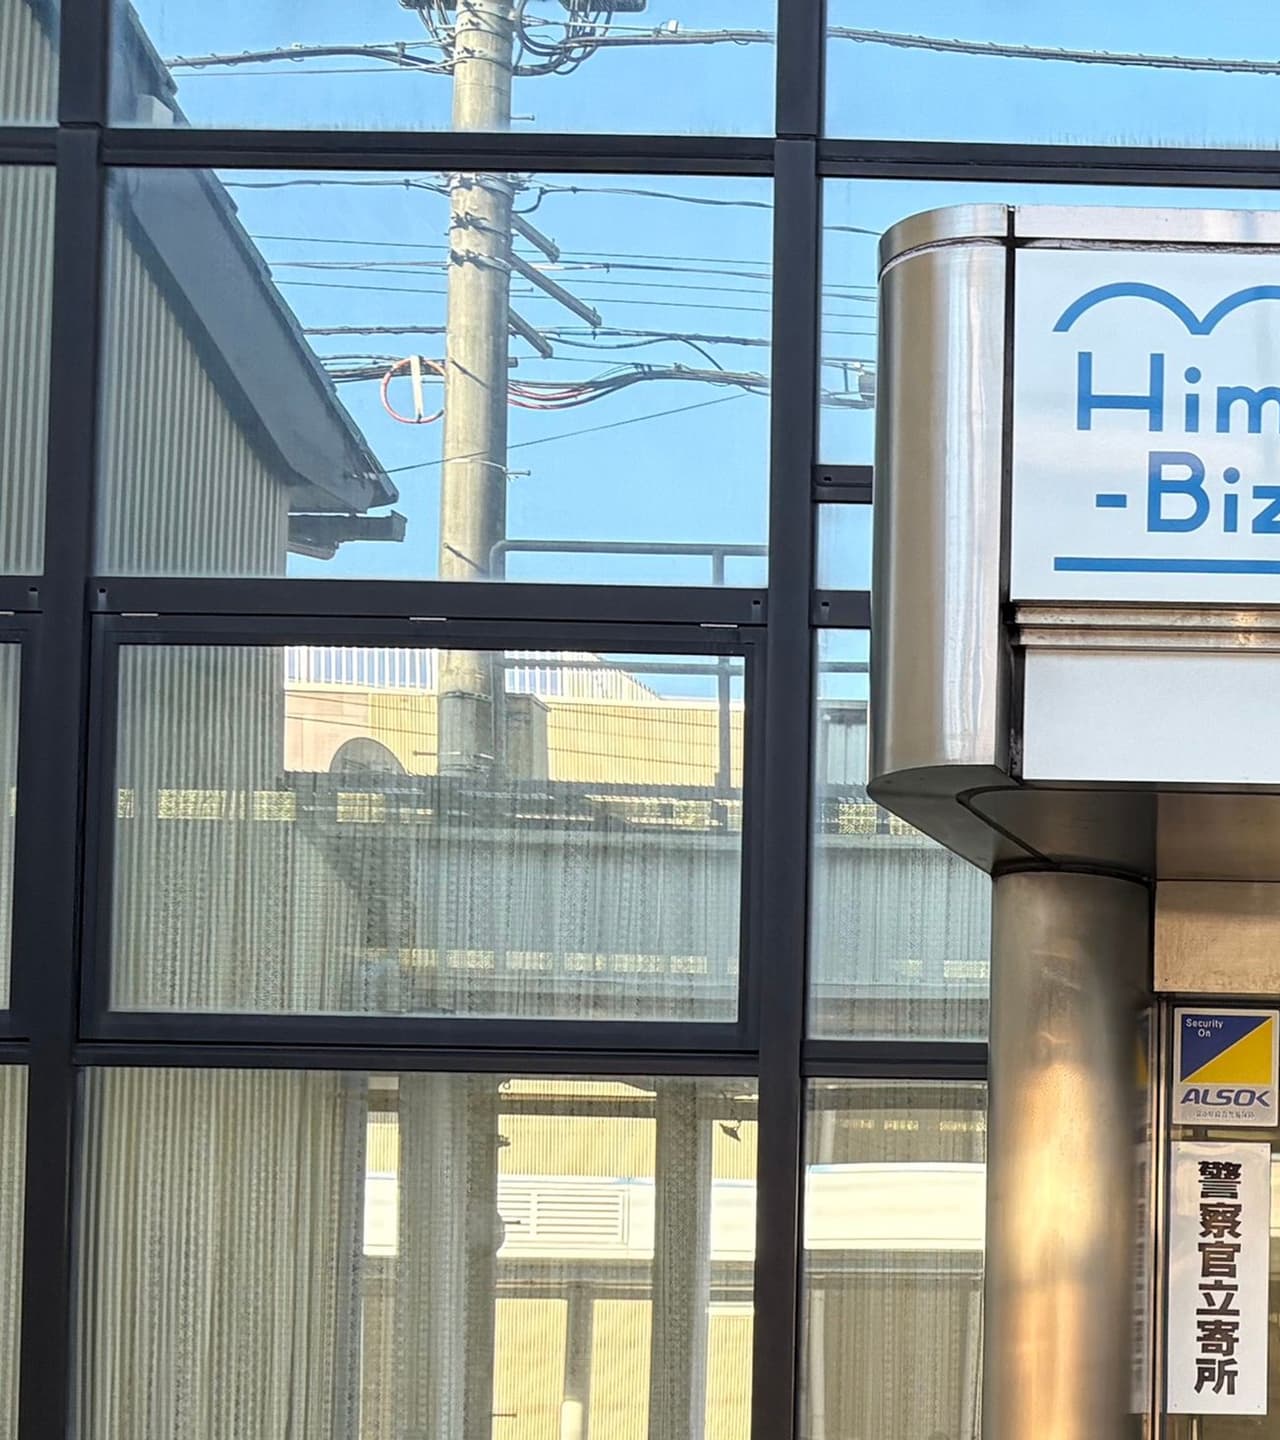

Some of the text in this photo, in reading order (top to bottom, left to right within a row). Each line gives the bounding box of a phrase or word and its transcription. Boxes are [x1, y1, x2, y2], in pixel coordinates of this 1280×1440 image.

[1185, 1018, 1223, 1028] Security
[1198, 1029, 1211, 1037] On
[1181, 1088, 1270, 1107] ALSOK
[1194, 1161, 1242, 1395] 警察官立寄所
